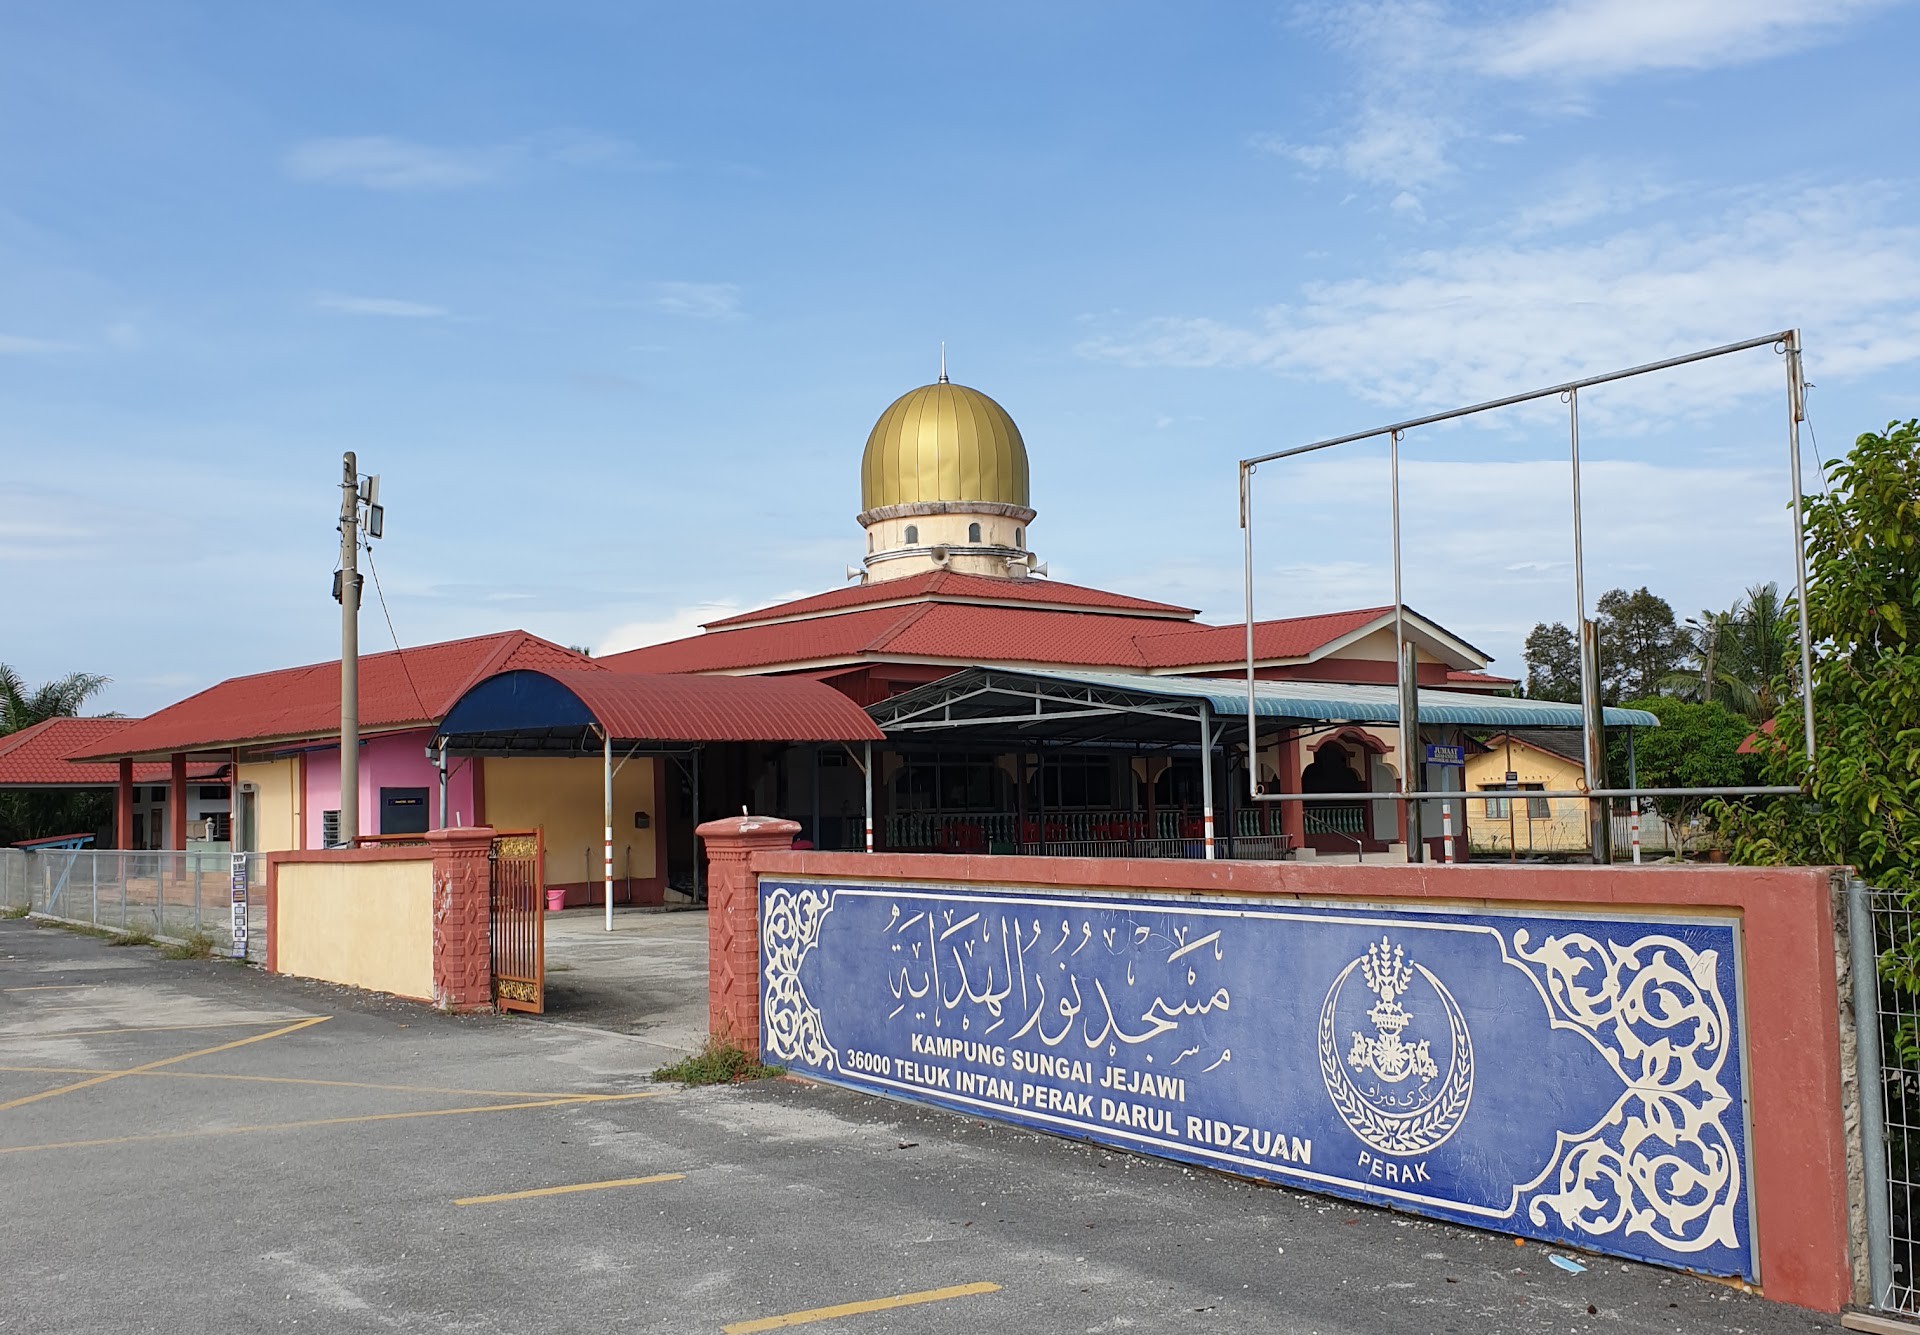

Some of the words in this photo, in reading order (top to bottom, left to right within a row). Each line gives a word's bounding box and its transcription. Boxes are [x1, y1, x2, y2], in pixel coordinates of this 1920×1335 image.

[1434, 746, 1458, 755] JUMAAT
[911, 1032, 1006, 1068] KAMPUNG
[1011, 1049, 1092, 1084] SUNGAI
[1099, 1065, 1185, 1102] JEJAWI
[847, 1049, 891, 1075] 36000
[895, 1058, 951, 1089] TELUK
[1101, 1098, 1179, 1136] DARUL
[1186, 1115, 1312, 1165] RIDZUAN
[1357, 1150, 1431, 1183] PERAK
